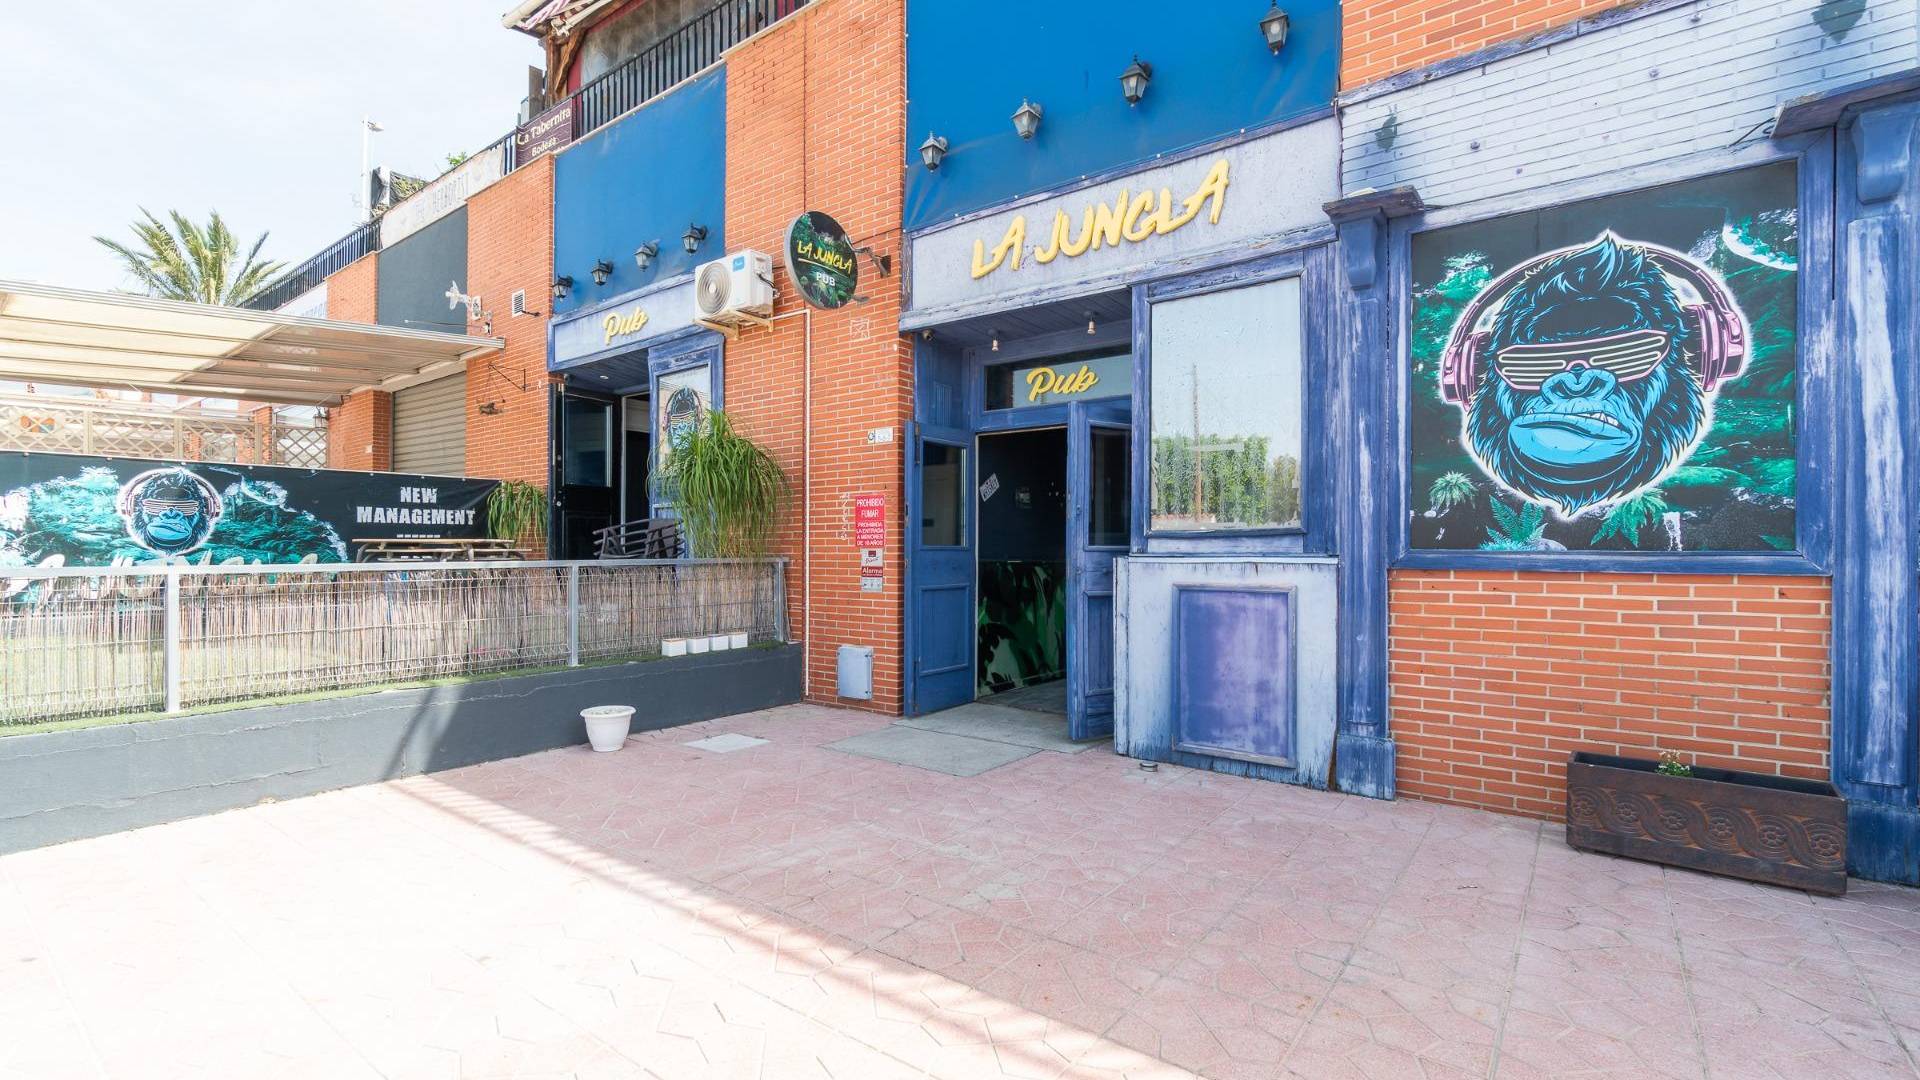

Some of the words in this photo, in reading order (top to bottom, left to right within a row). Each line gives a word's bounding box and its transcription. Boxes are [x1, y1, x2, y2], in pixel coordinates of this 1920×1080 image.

[517, 133, 529, 145] La
[531, 107, 571, 138] Tabernita
[971, 215, 1026, 279] LA
[1034, 159, 1230, 263] JUNGLA
[797, 240, 813, 258] LA
[814, 247, 852, 274] JUNGLA
[816, 271, 836, 287] PUB
[603, 306, 648, 345] Pub
[1026, 365, 1099, 401] Pub
[400, 487, 437, 503] NEW
[856, 498, 884, 507] PROHIBIDO
[356, 506, 475, 525] MANAGEMENT
[861, 509, 879, 518] FUMAR
